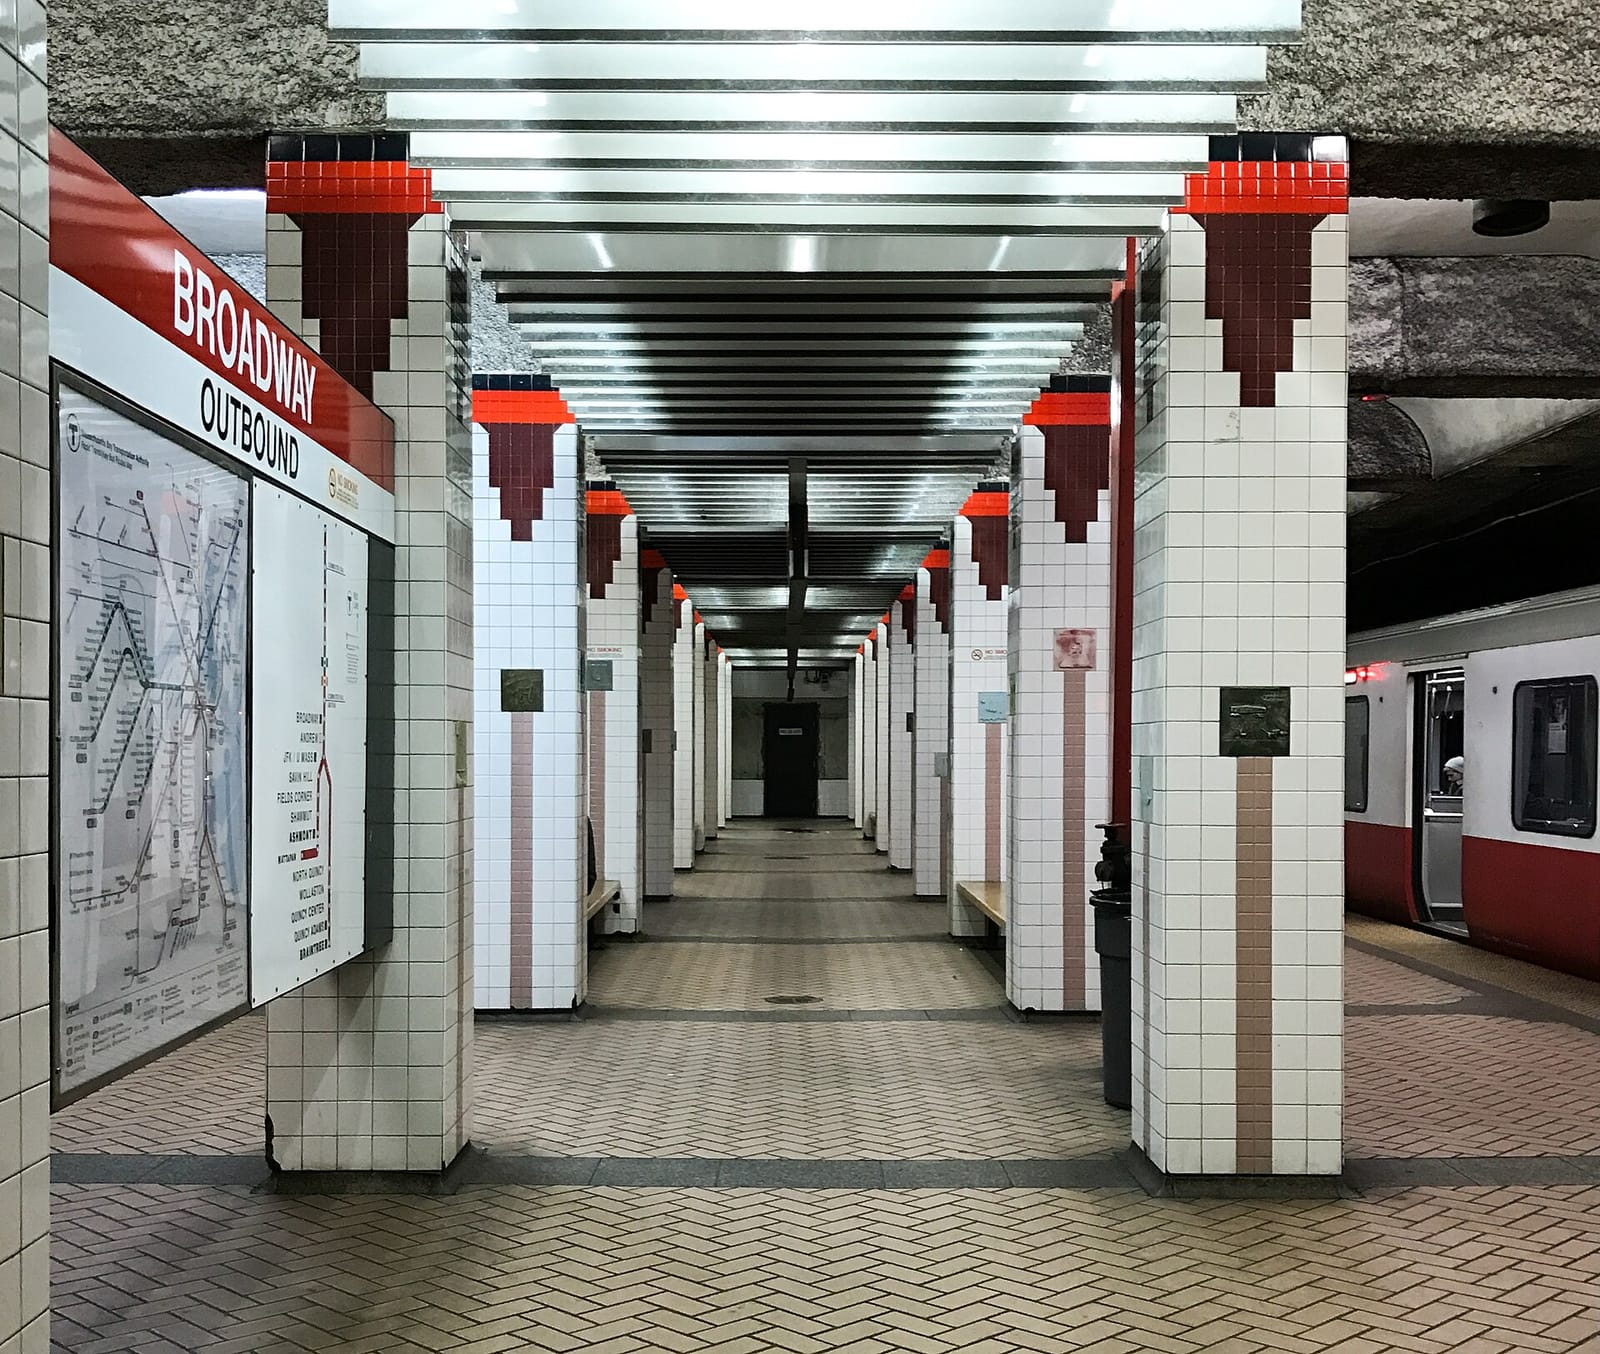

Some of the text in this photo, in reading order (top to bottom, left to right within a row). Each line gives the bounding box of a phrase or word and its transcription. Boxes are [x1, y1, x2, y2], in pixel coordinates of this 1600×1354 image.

[174, 249, 316, 424] BROADWAY
[200, 378, 299, 480] OUTBOUND
[277, 790, 313, 804] FIELDS CORNER
[289, 829, 313, 843] ASHMONT
[299, 884, 324, 900] WOLLASTON
[308, 902, 324, 917] CENTER
[299, 940, 325, 960] BRAINTREE
